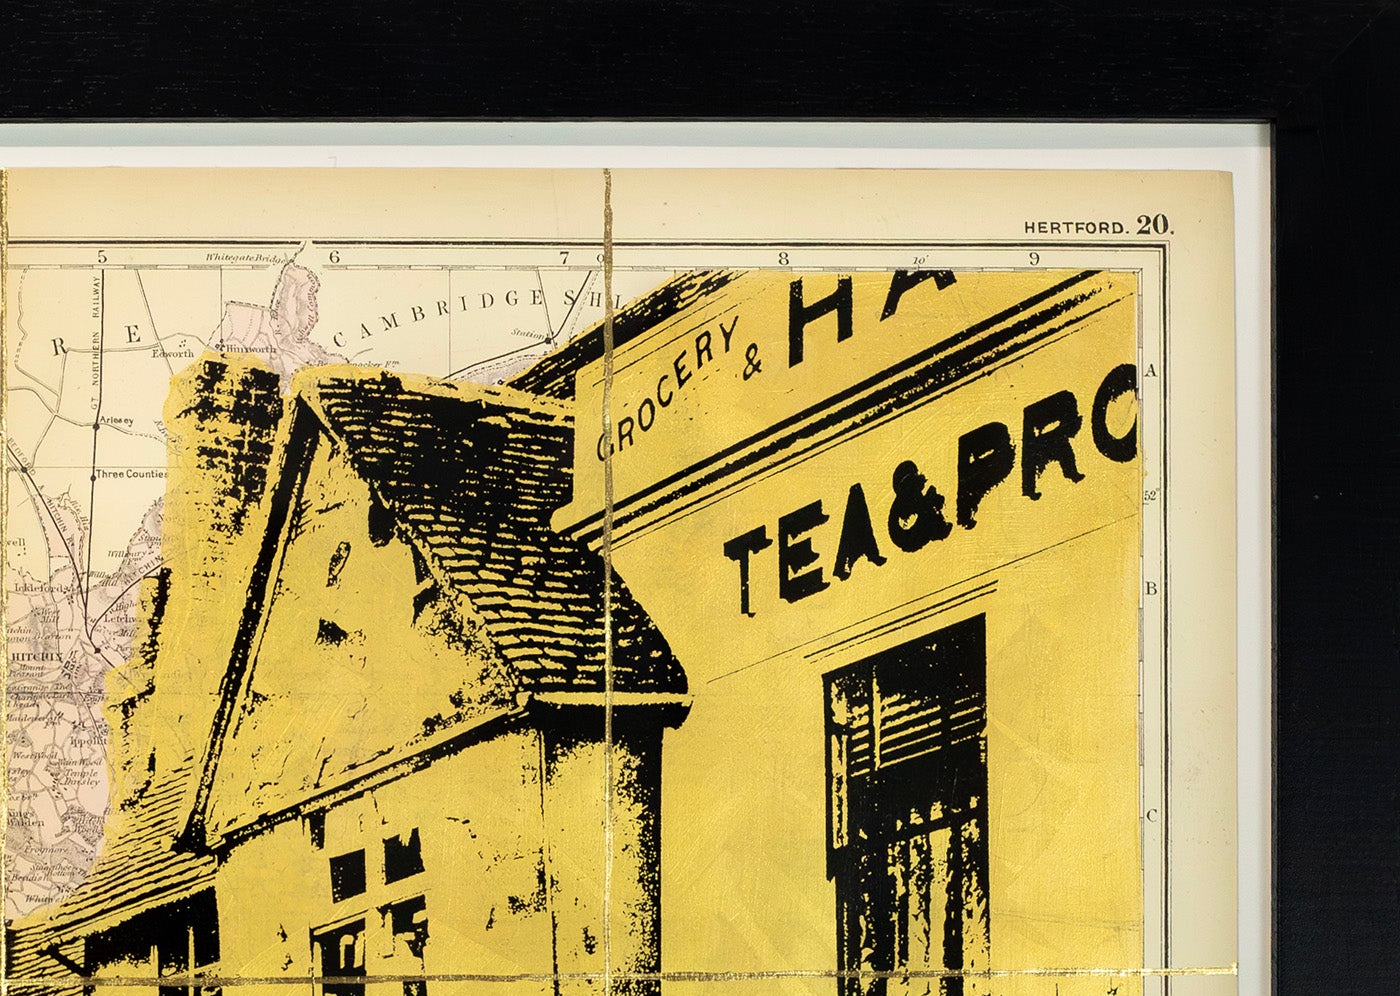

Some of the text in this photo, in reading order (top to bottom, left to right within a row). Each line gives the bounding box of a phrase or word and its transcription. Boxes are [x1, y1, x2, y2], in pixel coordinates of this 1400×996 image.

[1025, 213, 1175, 235] HERTFORD. 20.
[97, 250, 107, 263] 5
[329, 250, 341, 264] 6
[559, 252, 570, 264] 7
[778, 251, 790, 267] 8
[1029, 252, 1040, 266] 9
[92, 276, 101, 318] RAILWAY
[595, 315, 742, 464] GROCERY
[742, 342, 763, 382] &
[99, 415, 134, 427] Arlesey
[96, 469, 124, 479] Three
